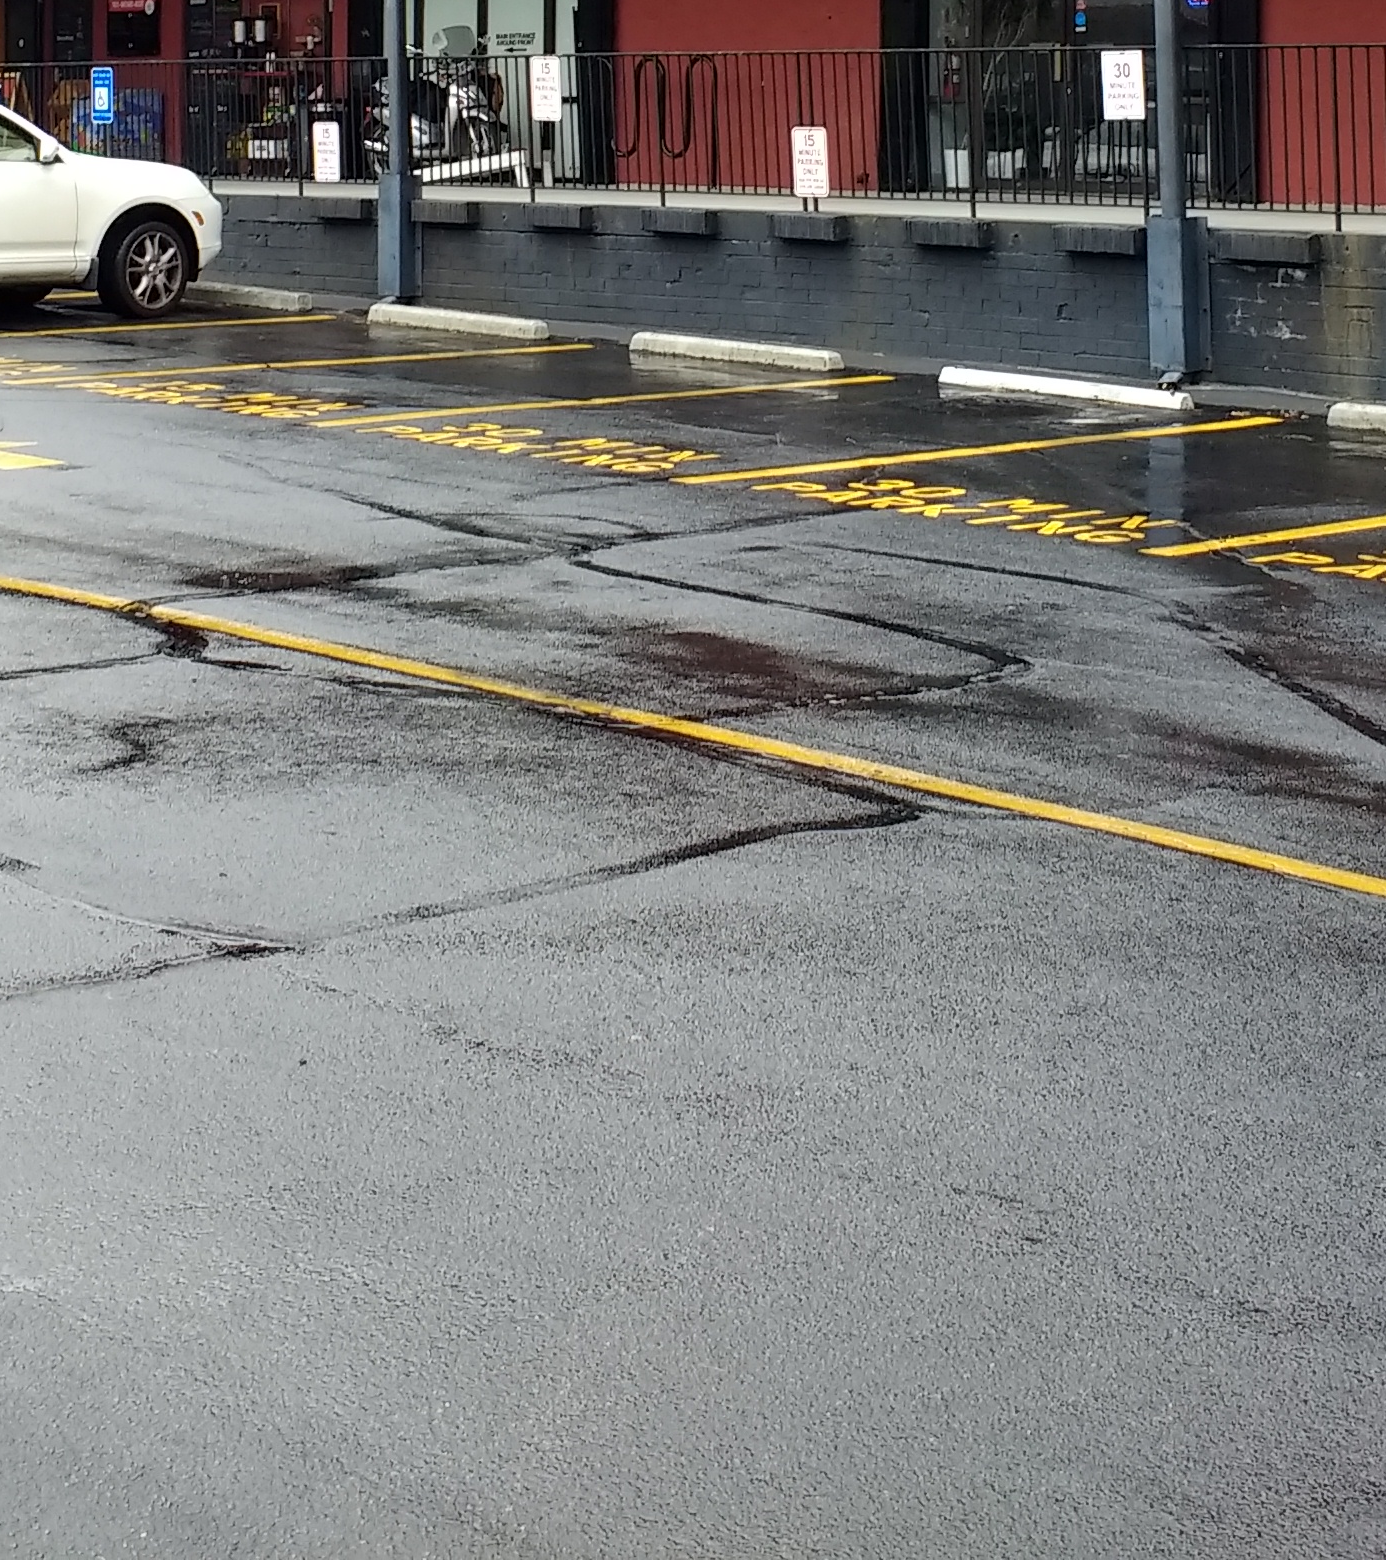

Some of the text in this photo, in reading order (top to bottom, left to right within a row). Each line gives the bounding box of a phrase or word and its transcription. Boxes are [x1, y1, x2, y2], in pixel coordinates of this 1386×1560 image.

[540, 62, 551, 75] 15
[1113, 63, 1131, 78] 30
[804, 134, 815, 147] 15
[355, 425, 675, 473] PARKING
[554, 438, 722, 462] MIN
[750, 481, 1146, 543] PARKING
[848, 479, 1180, 530] 30 MIN
